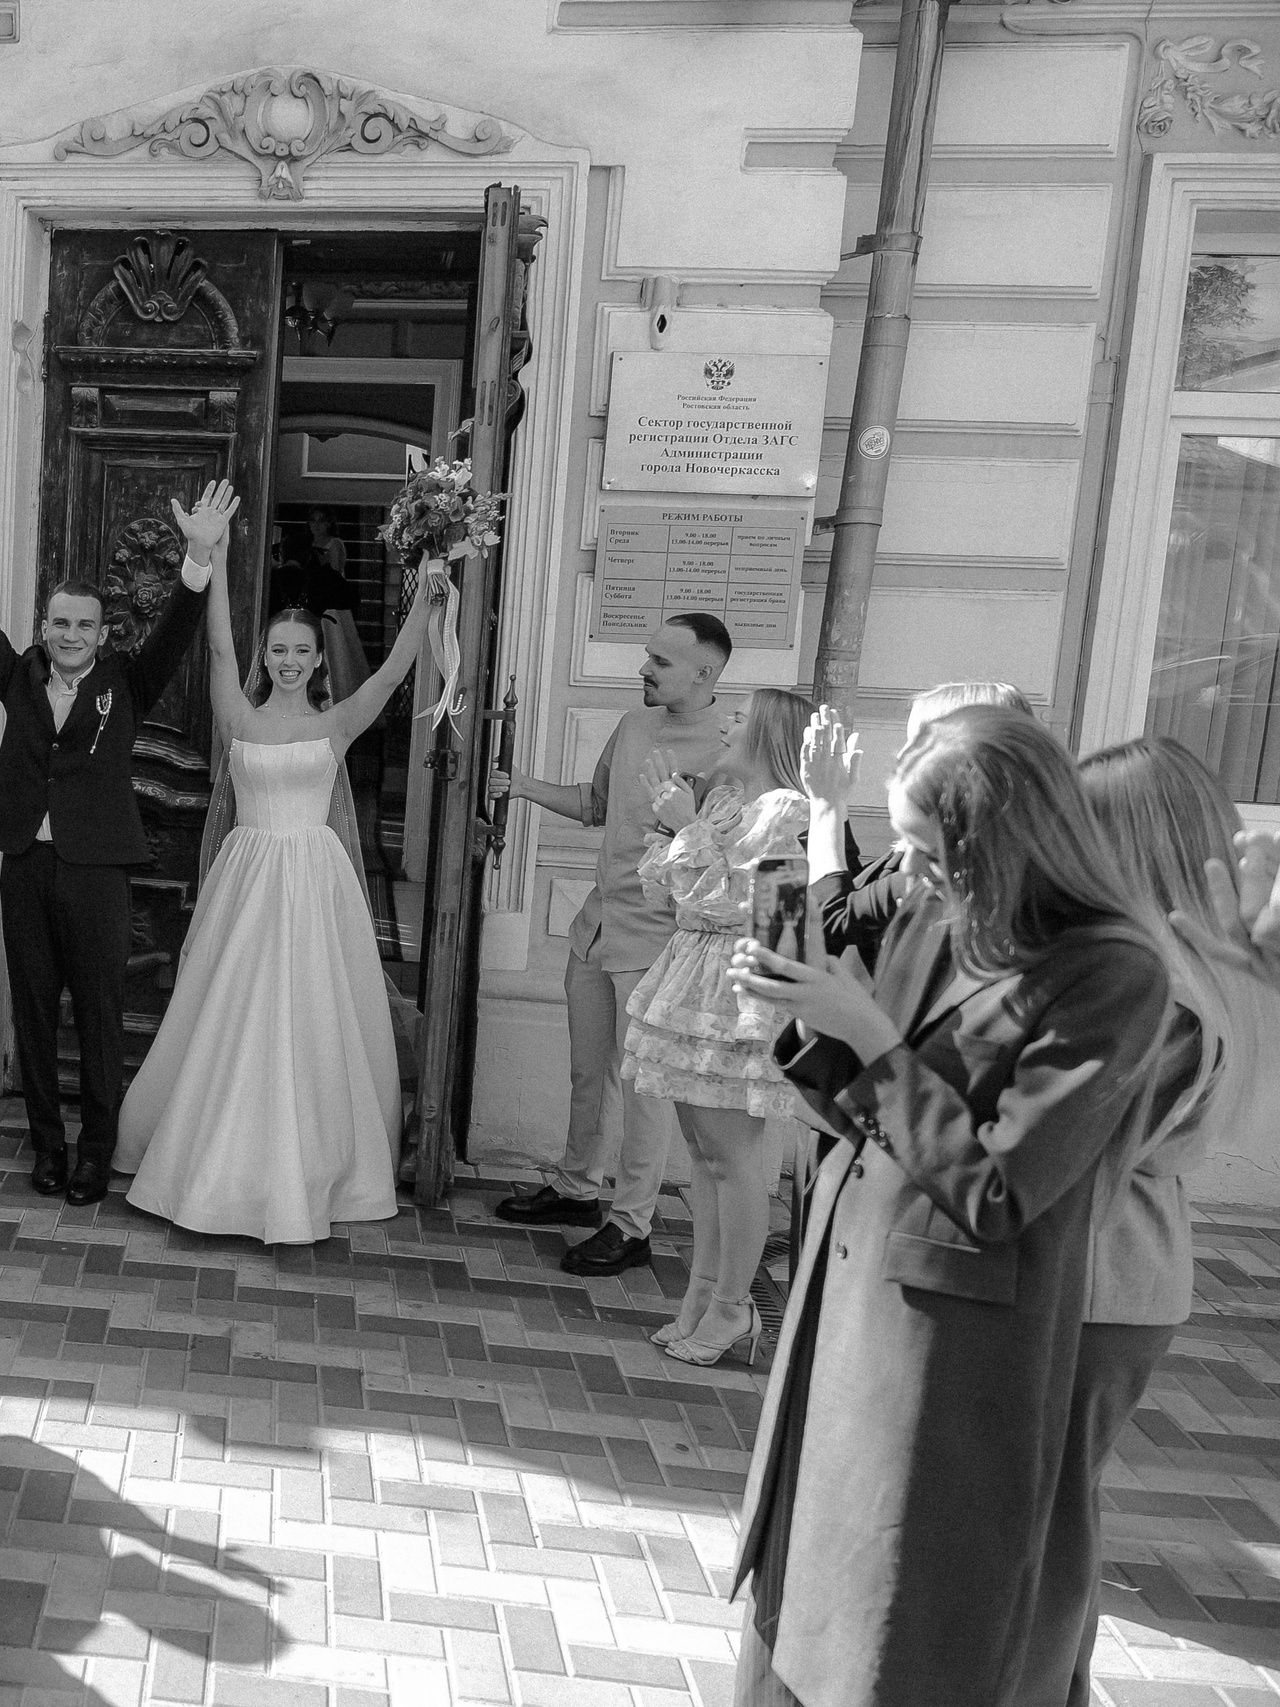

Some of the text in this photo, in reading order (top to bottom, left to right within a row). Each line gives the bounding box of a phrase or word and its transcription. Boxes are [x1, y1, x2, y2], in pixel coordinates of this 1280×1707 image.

[718, 395, 757, 403] Федерации
[682, 402, 750, 411] Ростовская область
[638, 416, 793, 432] Сектор государственной
[629, 433, 799, 446] регистрации Отдела ЗАГС
[660, 447, 764, 462] Администрации
[640, 463, 781, 477] города Новочеркасска
[661, 512, 743, 523] РЕЖИМ РАБОТЫ
[610, 529, 640, 537] Вторник
[609, 537, 630, 545] Среда
[608, 556, 636, 565] Четверг
[605, 584, 636, 592] Пятница
[604, 593, 632, 601] Суббота
[603, 612, 646, 620] Воскресенье
[602, 620, 648, 629] Понедельник
